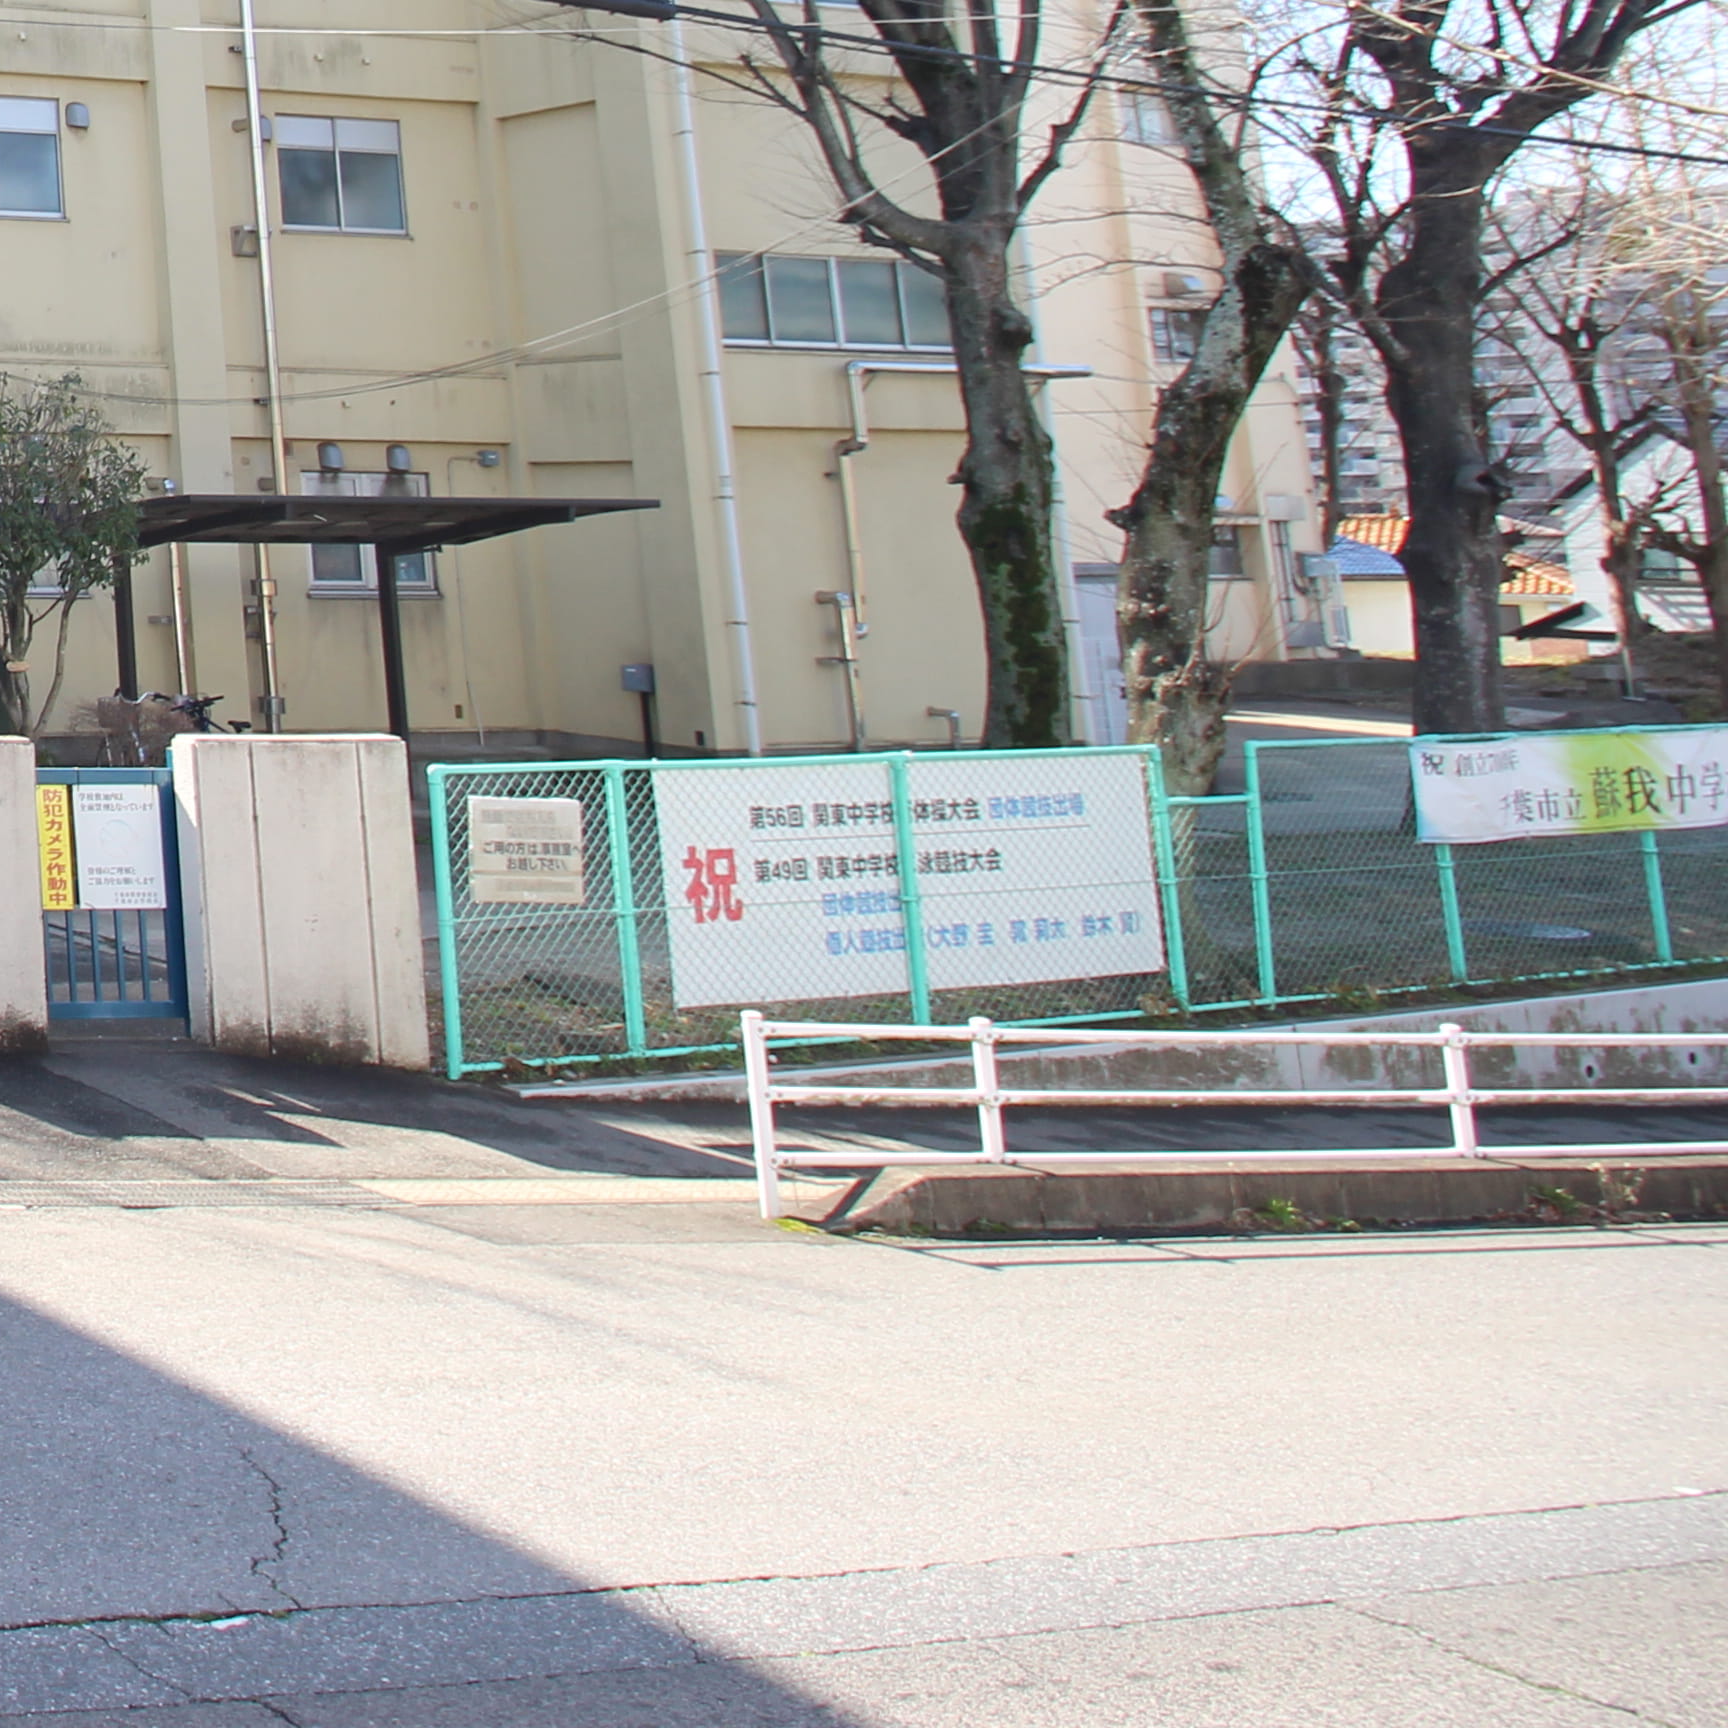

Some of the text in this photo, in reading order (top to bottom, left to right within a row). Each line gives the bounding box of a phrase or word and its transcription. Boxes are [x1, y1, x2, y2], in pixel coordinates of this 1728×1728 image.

[1421, 752, 1444, 775] 祝
[42, 789, 67, 906] 防犯カメラ作動中
[682, 846, 743, 924] 祝
